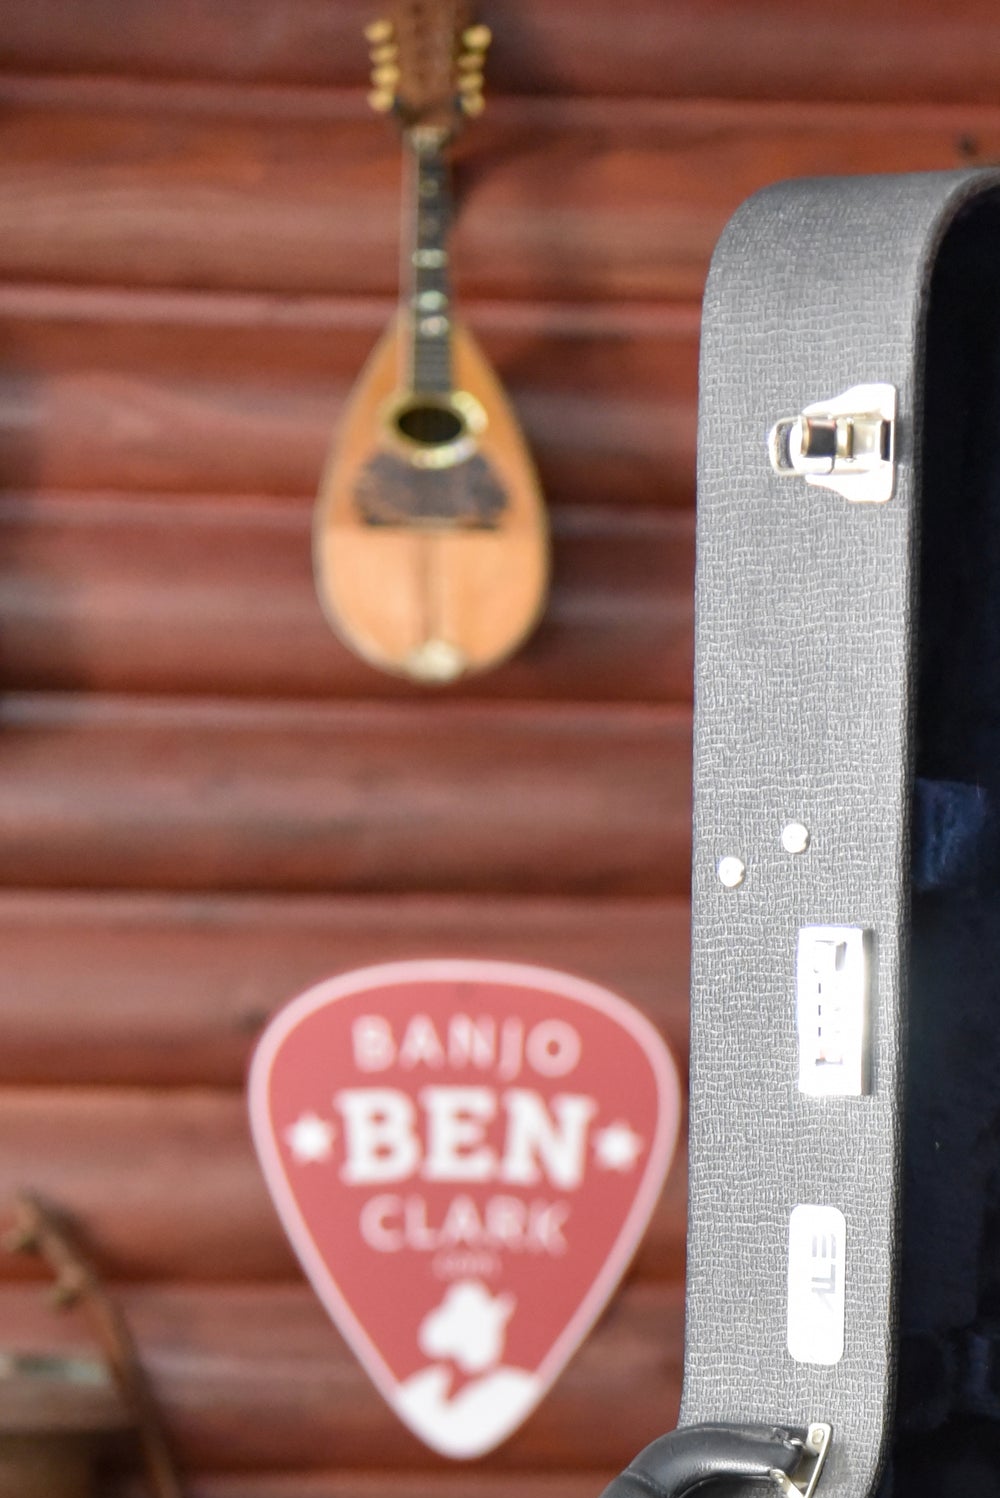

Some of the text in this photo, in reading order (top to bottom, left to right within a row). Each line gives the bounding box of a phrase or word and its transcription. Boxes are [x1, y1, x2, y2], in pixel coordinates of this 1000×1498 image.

[351, 1013, 582, 1081] BANJO
[336, 1085, 596, 1191] BEN
[358, 1194, 571, 1256] CLARK
